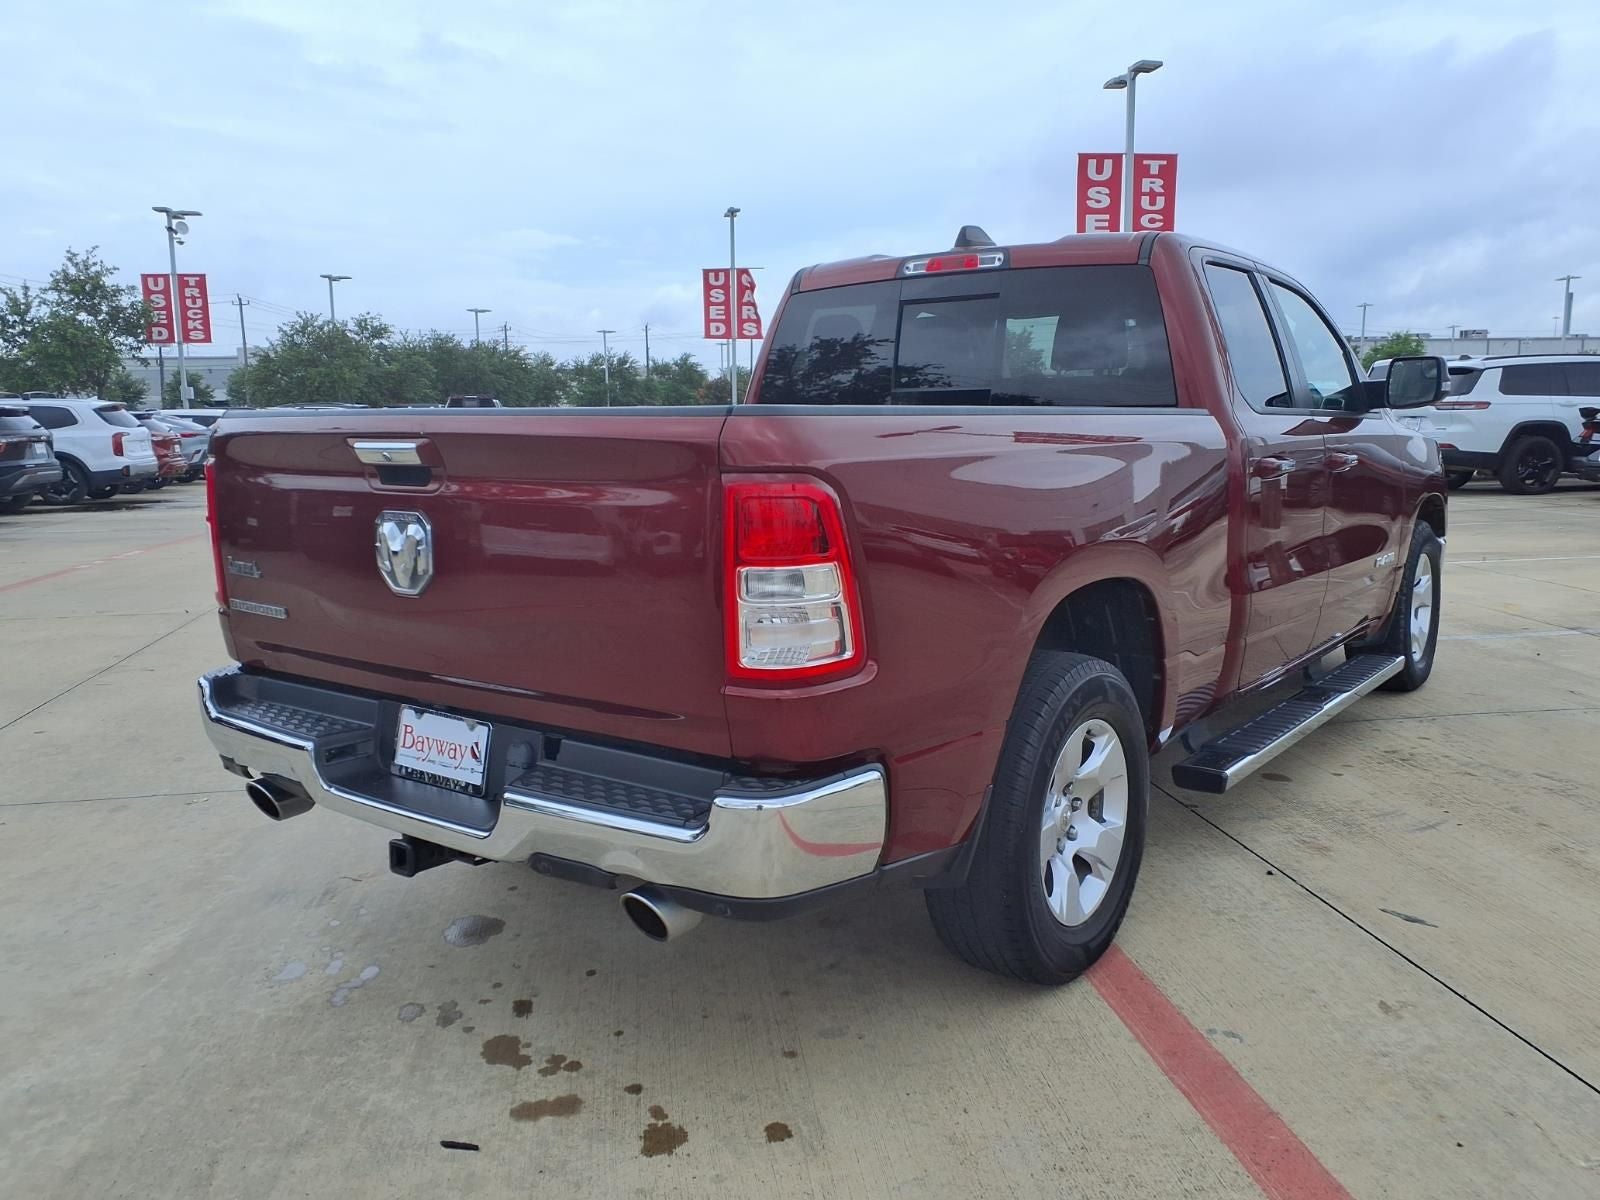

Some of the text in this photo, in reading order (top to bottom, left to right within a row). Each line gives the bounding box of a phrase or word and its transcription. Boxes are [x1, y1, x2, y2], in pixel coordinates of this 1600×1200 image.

[1085, 158, 1113, 233] USE
[1140, 160, 1167, 229] TRUC
[147, 277, 169, 341] USED
[184, 277, 205, 340] TRUCKS
[708, 272, 726, 336] USED
[741, 273, 758, 336] CARS
[401, 724, 468, 770] Bayway
